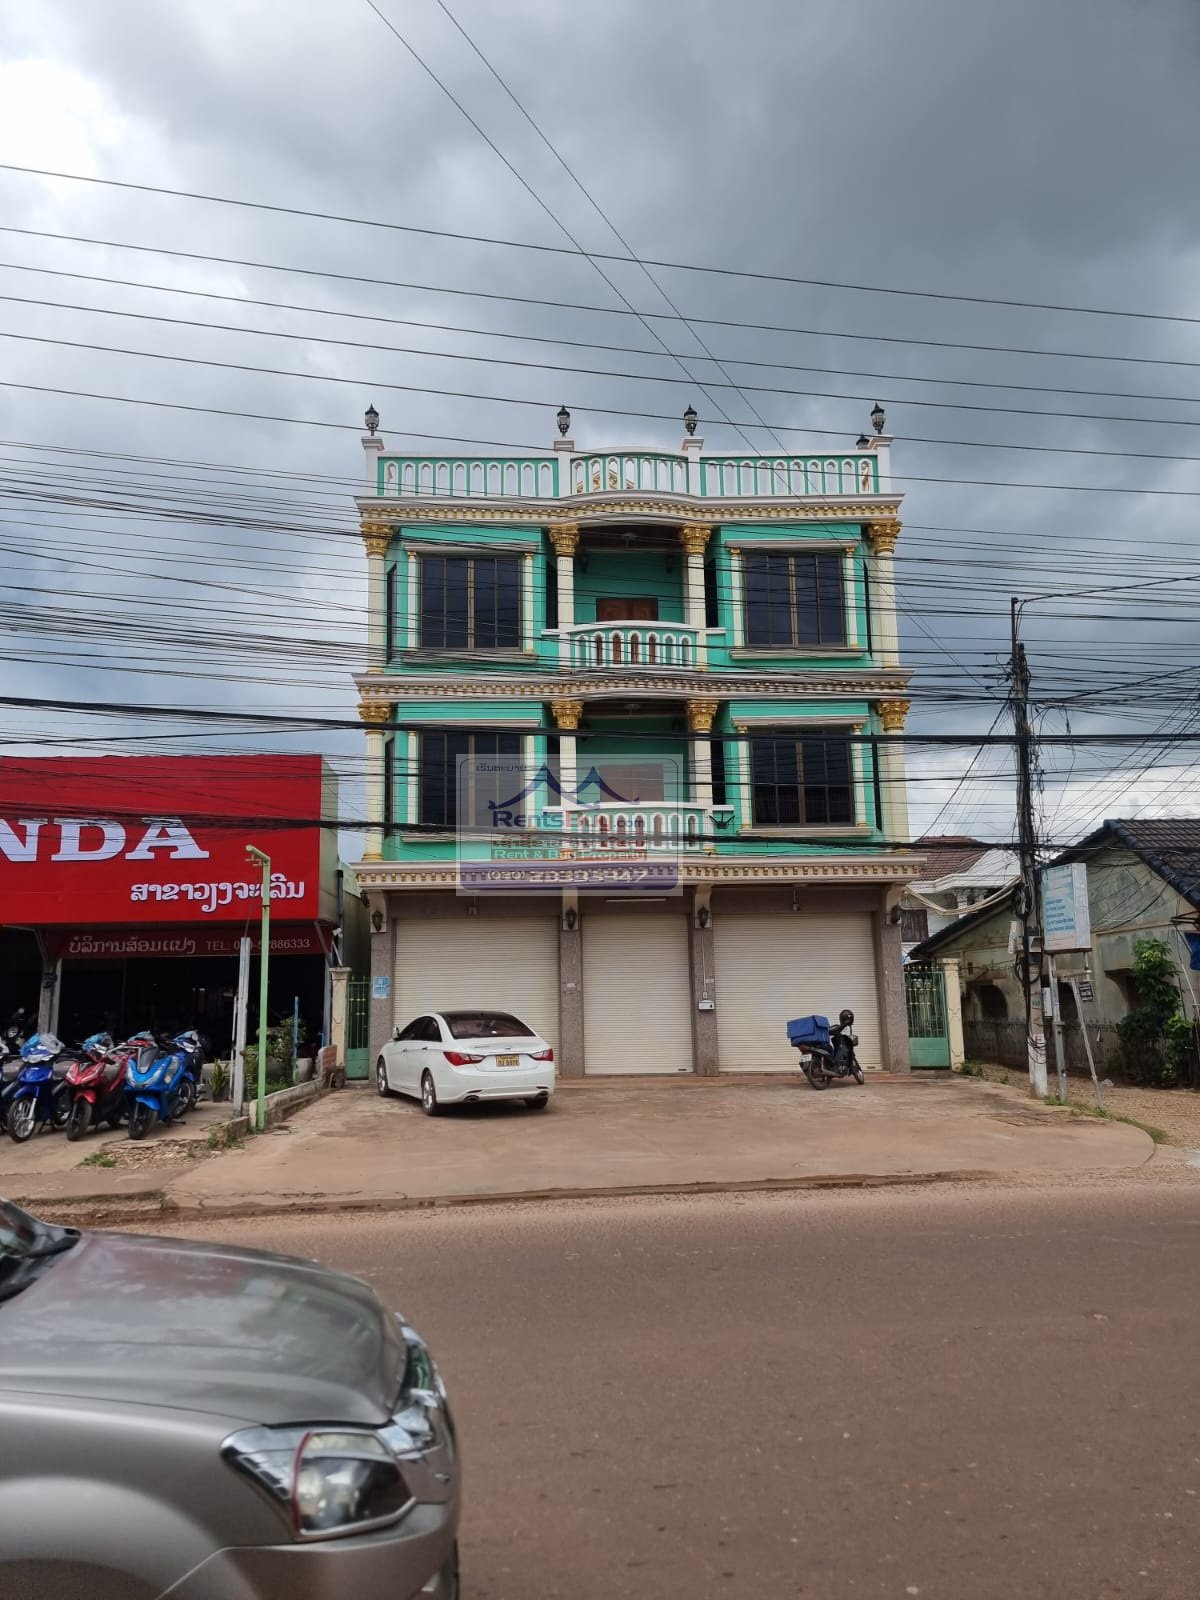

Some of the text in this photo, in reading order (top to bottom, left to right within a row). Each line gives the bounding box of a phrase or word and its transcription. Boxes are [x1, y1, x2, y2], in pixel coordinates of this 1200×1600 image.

[130, 872, 305, 913] ສາຂາວຽງຈະລີນ
